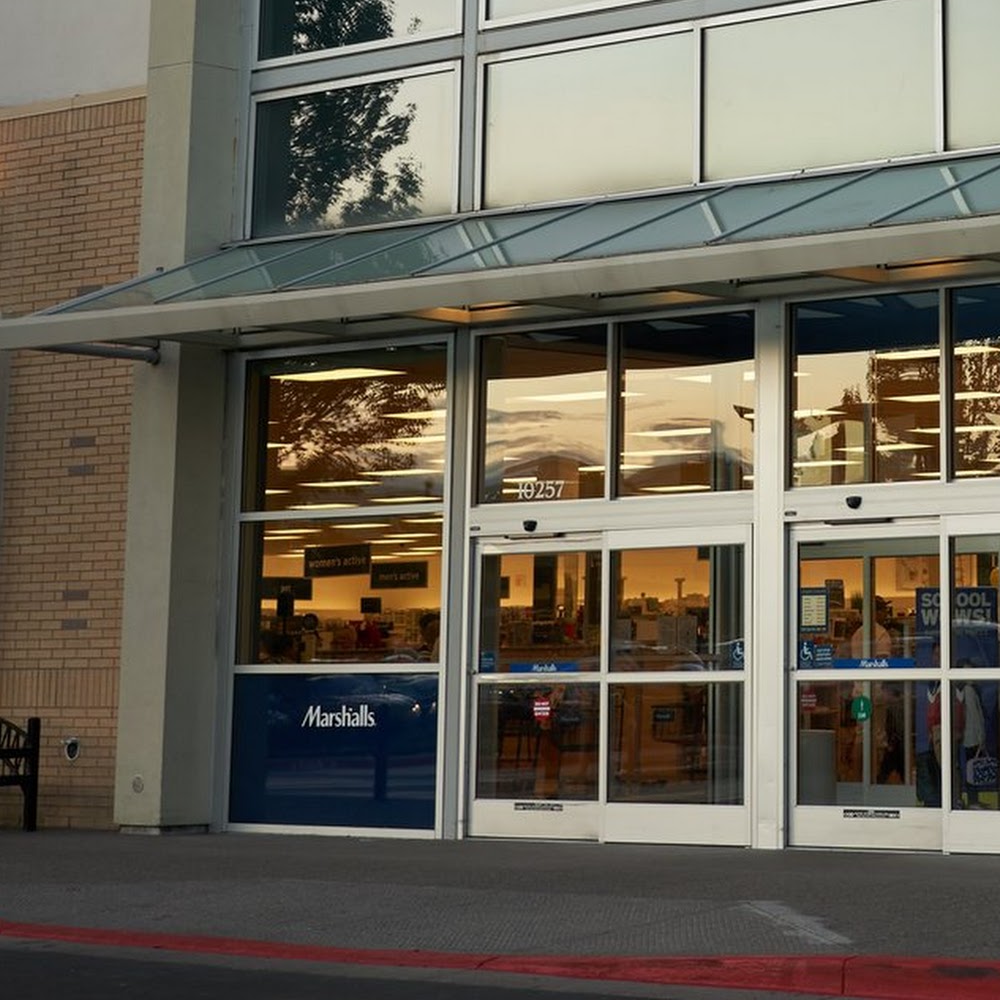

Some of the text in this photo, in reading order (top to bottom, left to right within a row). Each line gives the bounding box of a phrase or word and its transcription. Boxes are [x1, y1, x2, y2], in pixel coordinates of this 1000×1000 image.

[518, 480, 565, 499] 10257
[308, 555, 367, 568] women's active
[921, 592, 992, 607] SCOOL
[921, 607, 992, 626] WWS!
[301, 704, 376, 727] Marshalls
